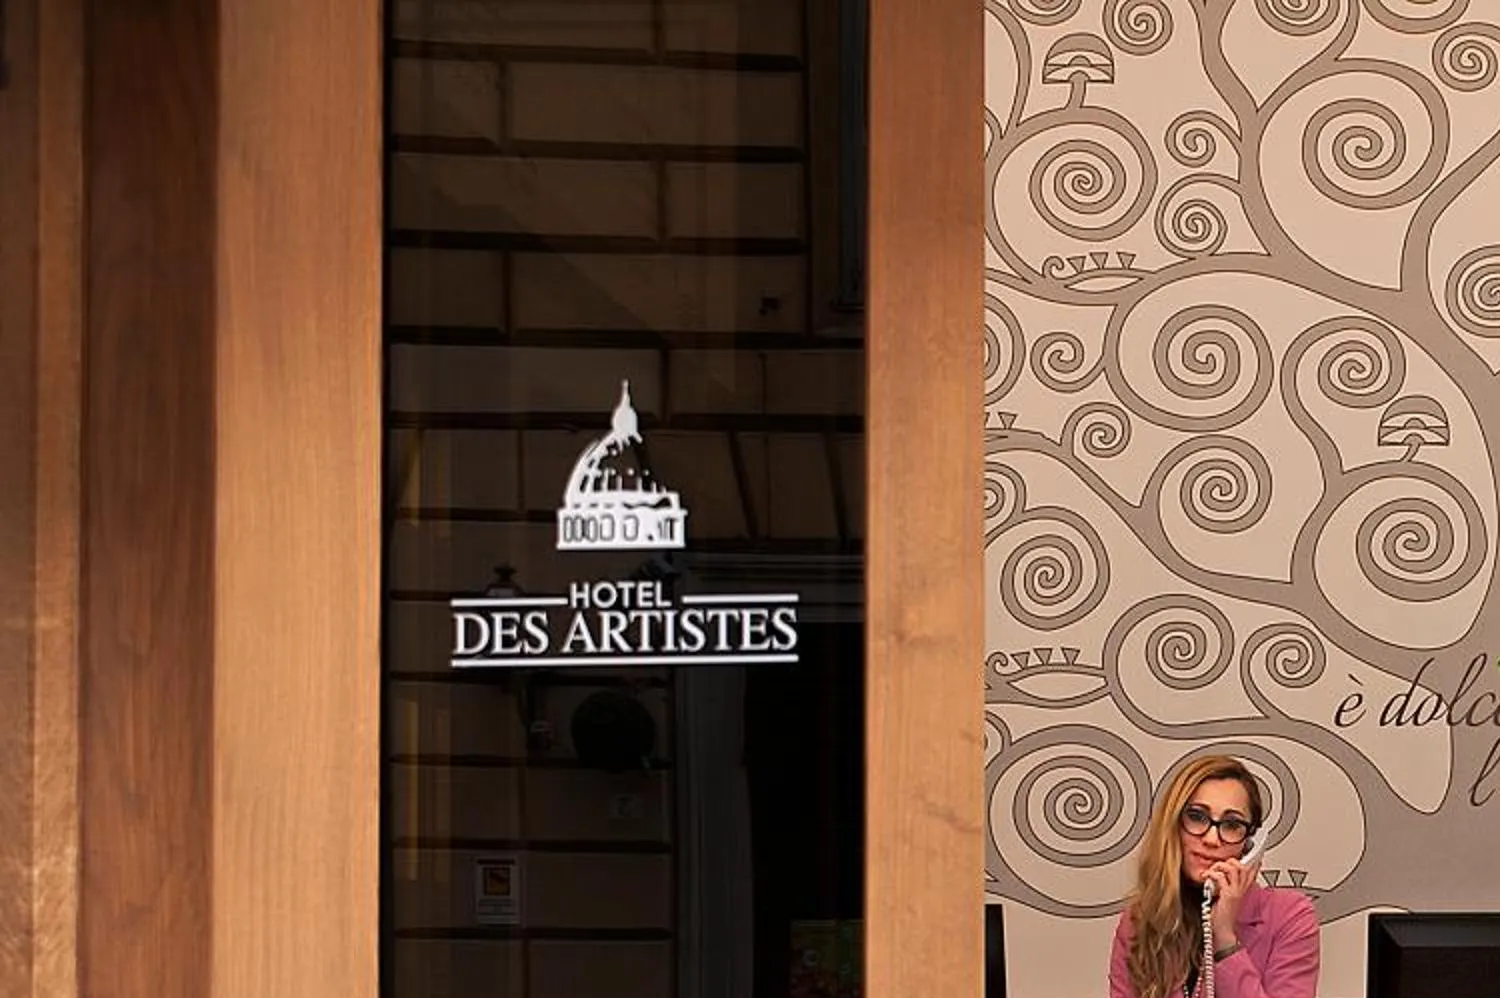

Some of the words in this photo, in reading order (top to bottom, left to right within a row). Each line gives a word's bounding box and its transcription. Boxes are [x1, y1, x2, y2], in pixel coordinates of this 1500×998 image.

[569, 581, 673, 609] HOTEL
[453, 610, 549, 656] DES
[560, 607, 798, 654] ARTISTES
[1334, 672, 1366, 728] è
